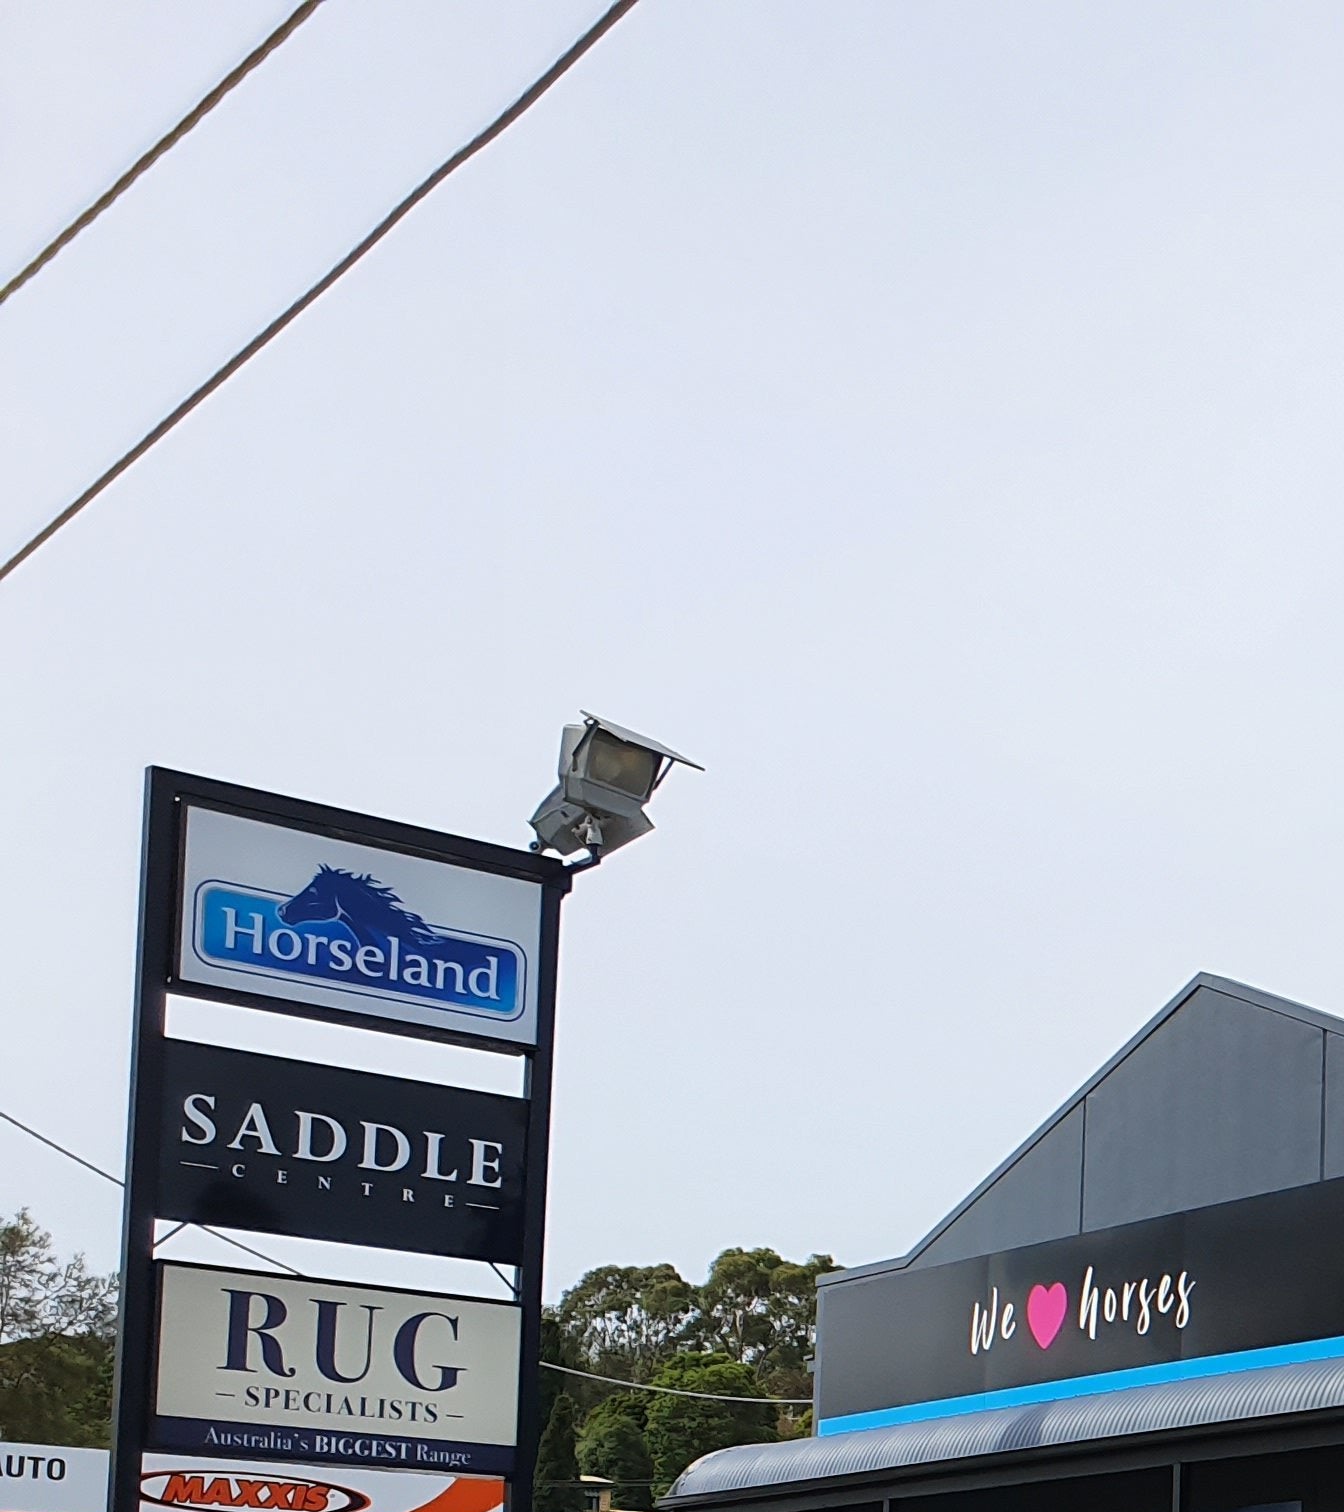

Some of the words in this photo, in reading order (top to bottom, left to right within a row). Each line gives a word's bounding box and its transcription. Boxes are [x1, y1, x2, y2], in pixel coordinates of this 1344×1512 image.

[222, 906, 502, 1001] Horseland
[181, 1094, 504, 1189] SADDLE
[232, 1163, 455, 1208] CENTRE
[969, 1286, 1017, 1355] We
[1078, 1265, 1197, 1340] horses
[216, 1287, 468, 1392] RUG
[244, 1385, 439, 1424] SPECIALISTS
[0, 1454, 66, 1481] UTO
[204, 1426, 309, 1452] Australia's
[314, 1435, 412, 1460] BIGGEST
[416, 1443, 472, 1467] Range
[161, 1474, 331, 1512] MAXXIS
